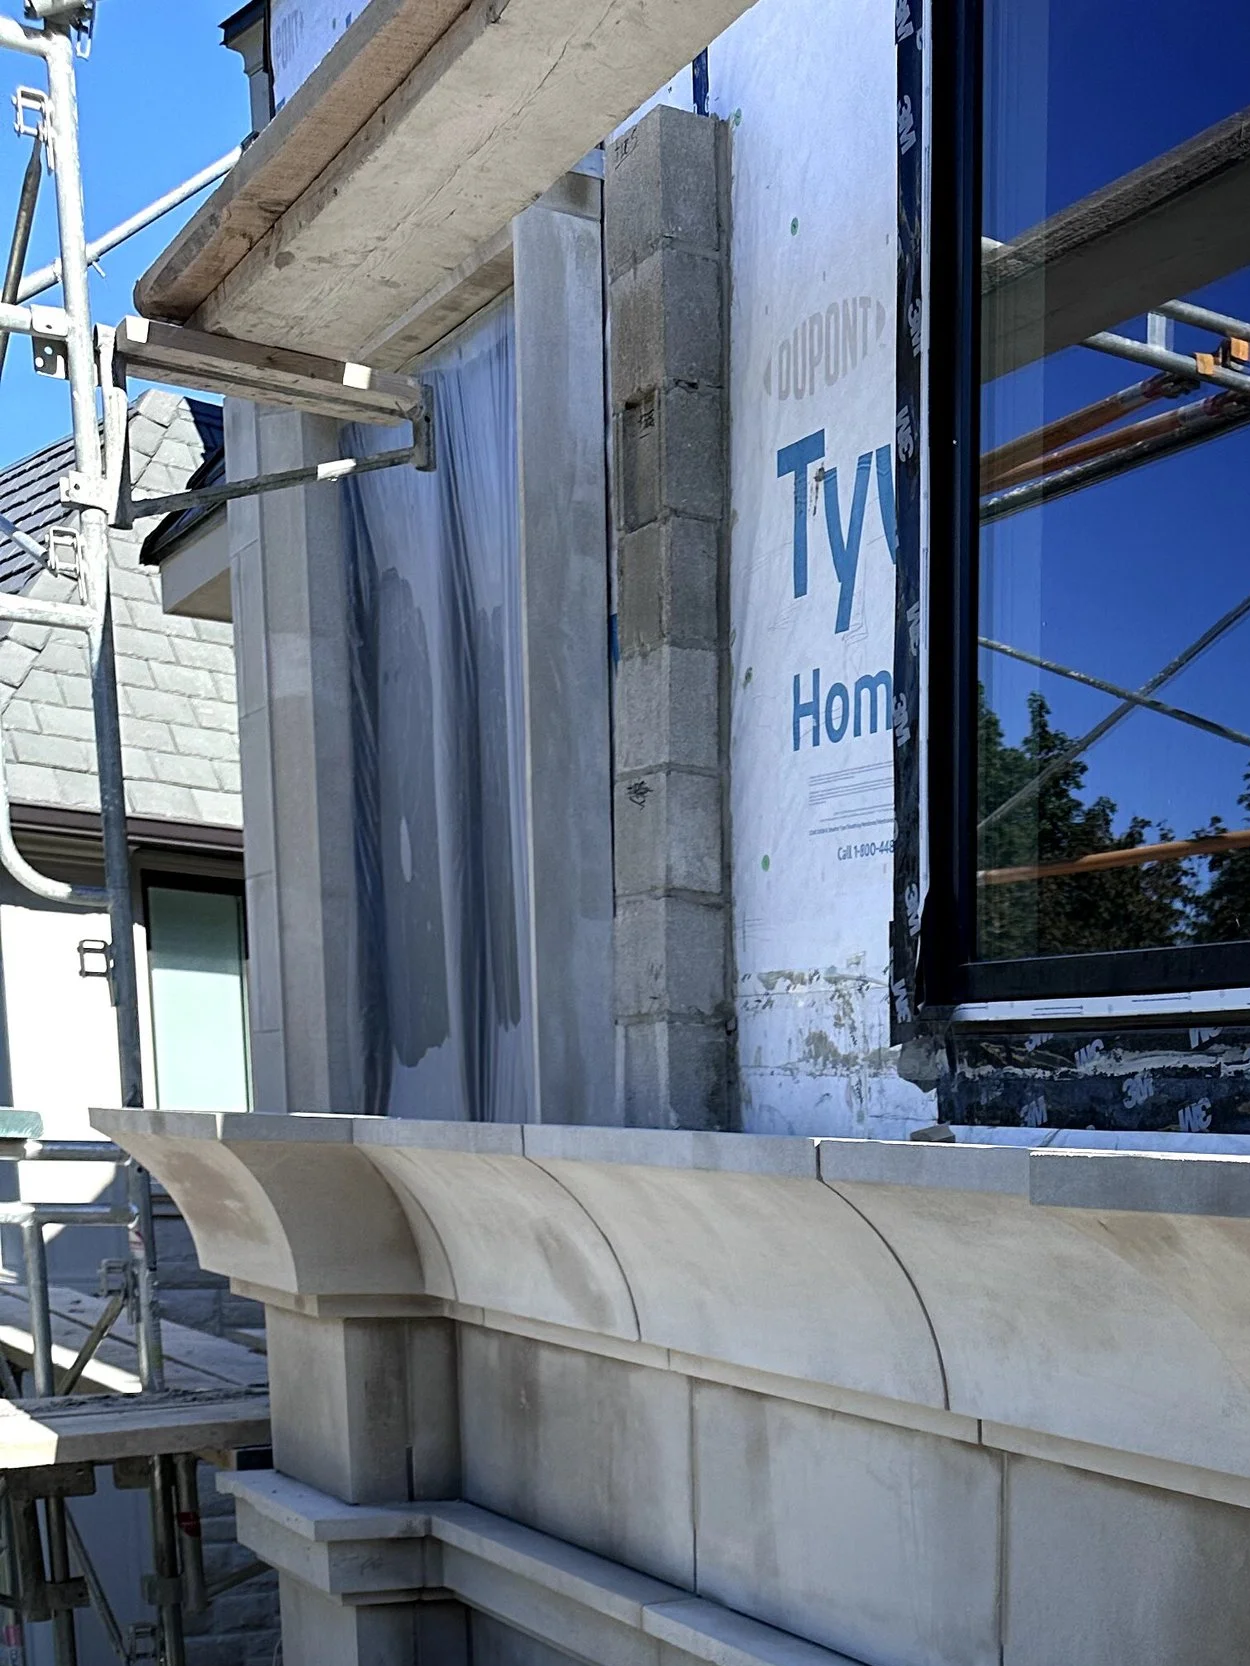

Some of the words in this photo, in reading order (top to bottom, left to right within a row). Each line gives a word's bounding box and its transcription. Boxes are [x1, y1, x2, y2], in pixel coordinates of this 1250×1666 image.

[778, 296, 871, 401] DUPONT
[896, 404, 914, 463] 3M
[793, 667, 894, 752] Hom
[892, 692, 912, 748] 3M
[837, 844, 853, 861] Call
[904, 882, 922, 937] 3M
[1178, 1096, 1213, 1133] 3M
